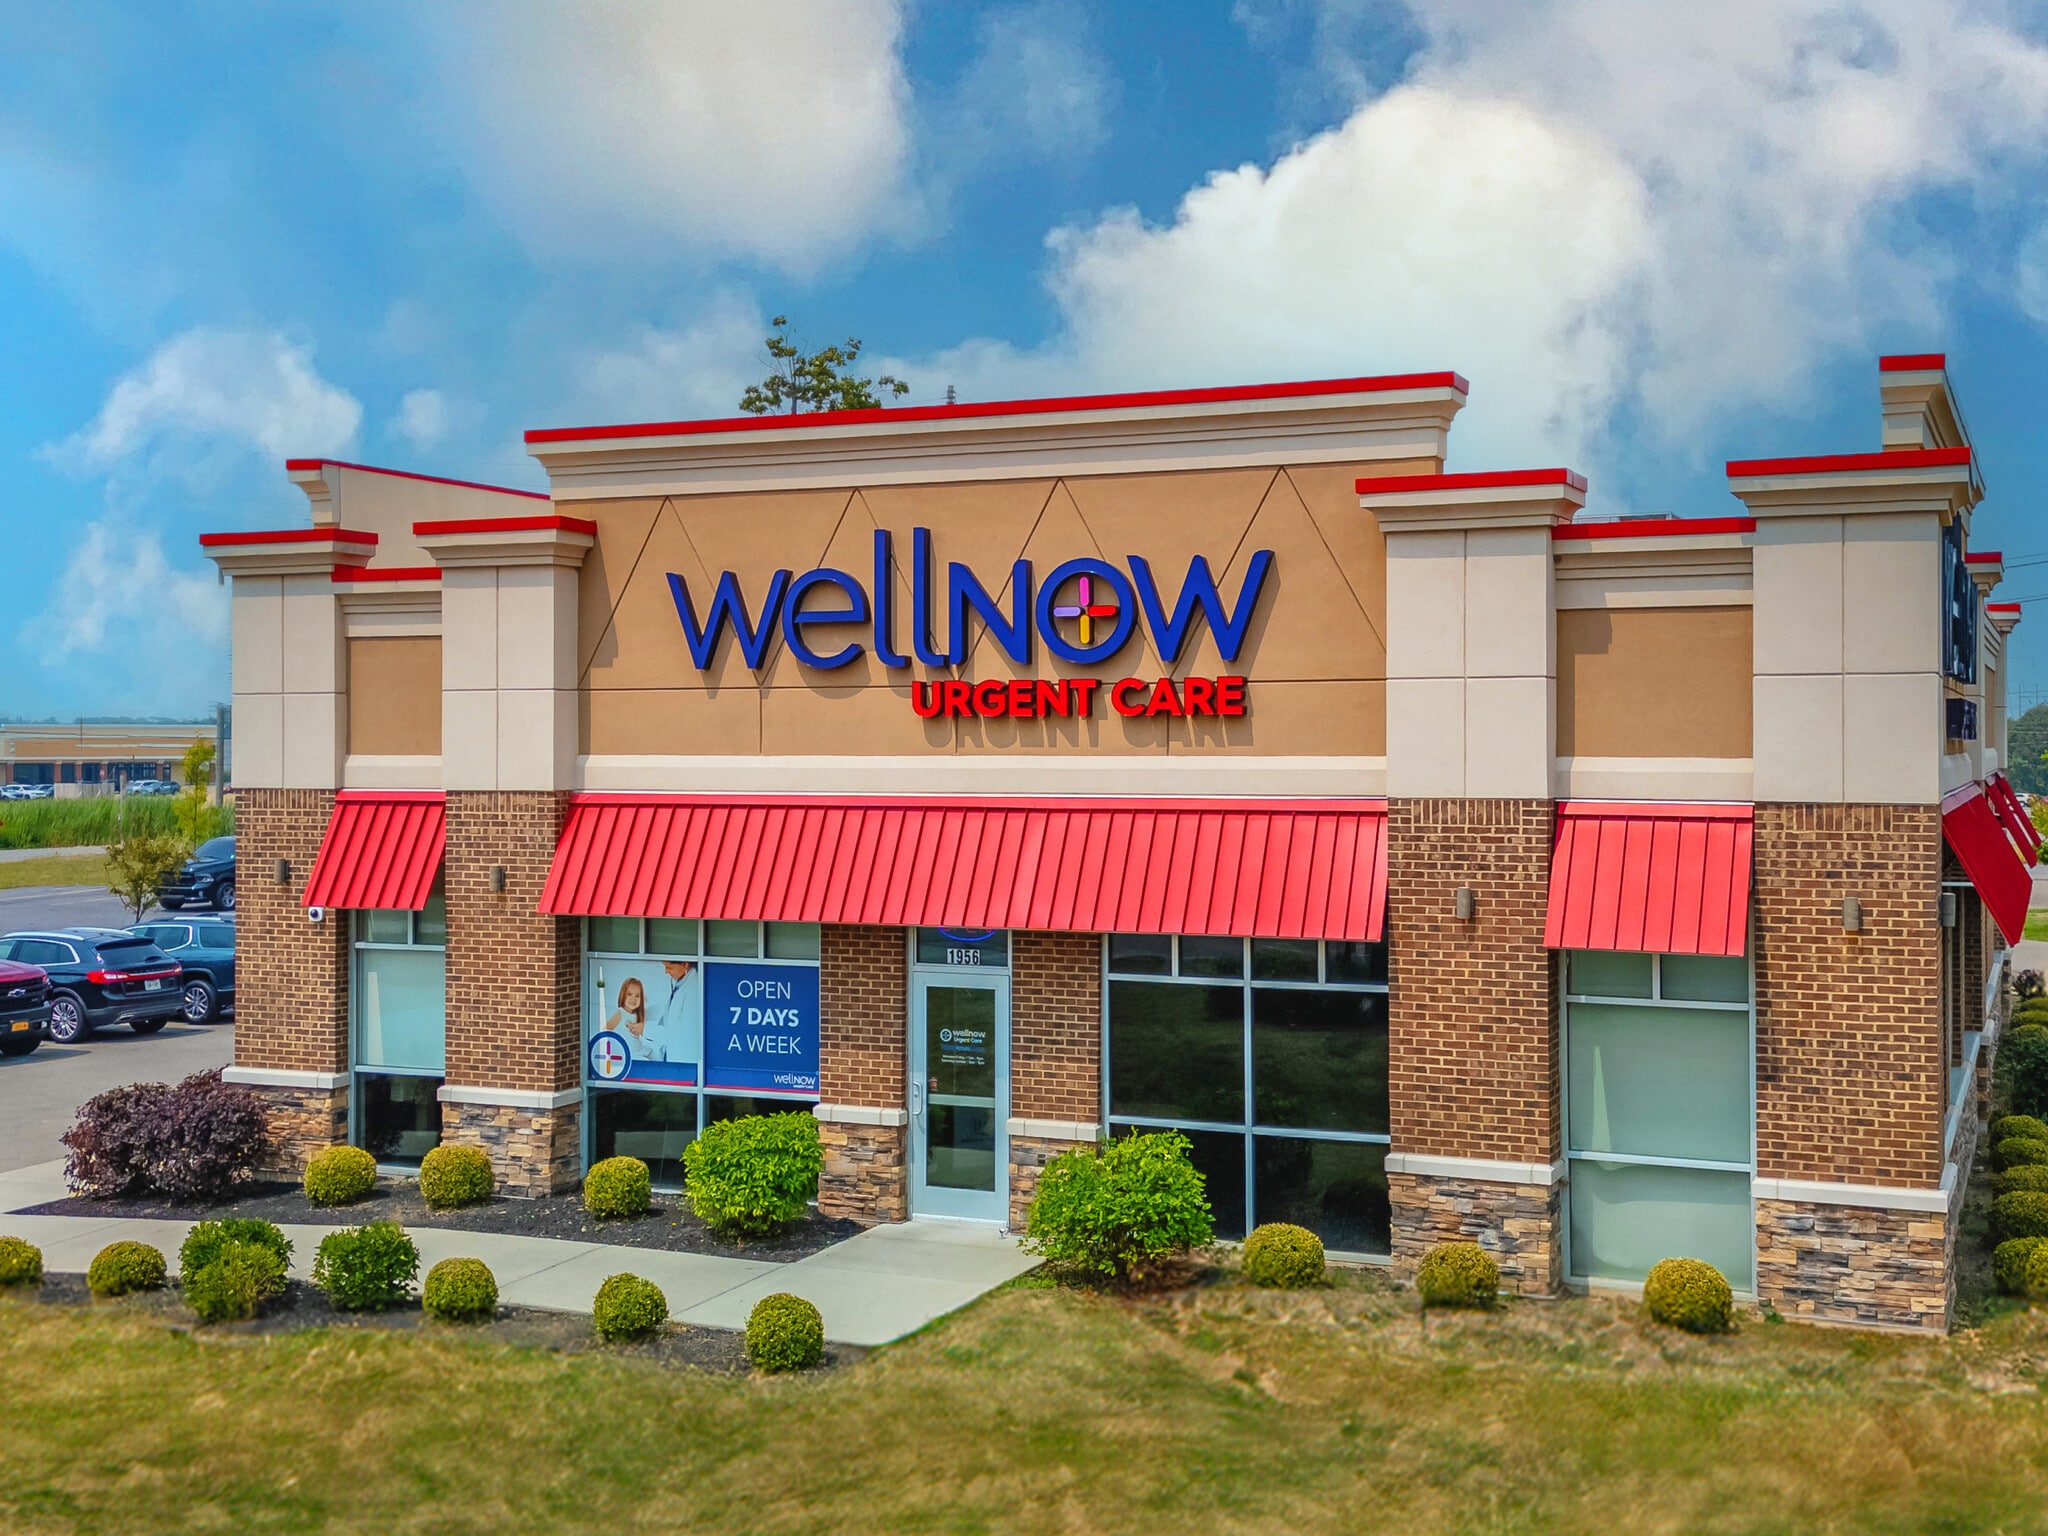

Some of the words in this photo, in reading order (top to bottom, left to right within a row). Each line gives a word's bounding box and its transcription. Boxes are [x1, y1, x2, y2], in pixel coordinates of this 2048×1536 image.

[911, 678, 1097, 718] URGENT
[1110, 676, 1248, 717] CARE
[949, 949, 979, 965] 1956
[737, 980, 791, 999] OPEN
[729, 1006, 742, 1025] 7
[747, 1007, 799, 1027] DAYS
[727, 1033, 742, 1051] A
[746, 1034, 802, 1055] WEEK
